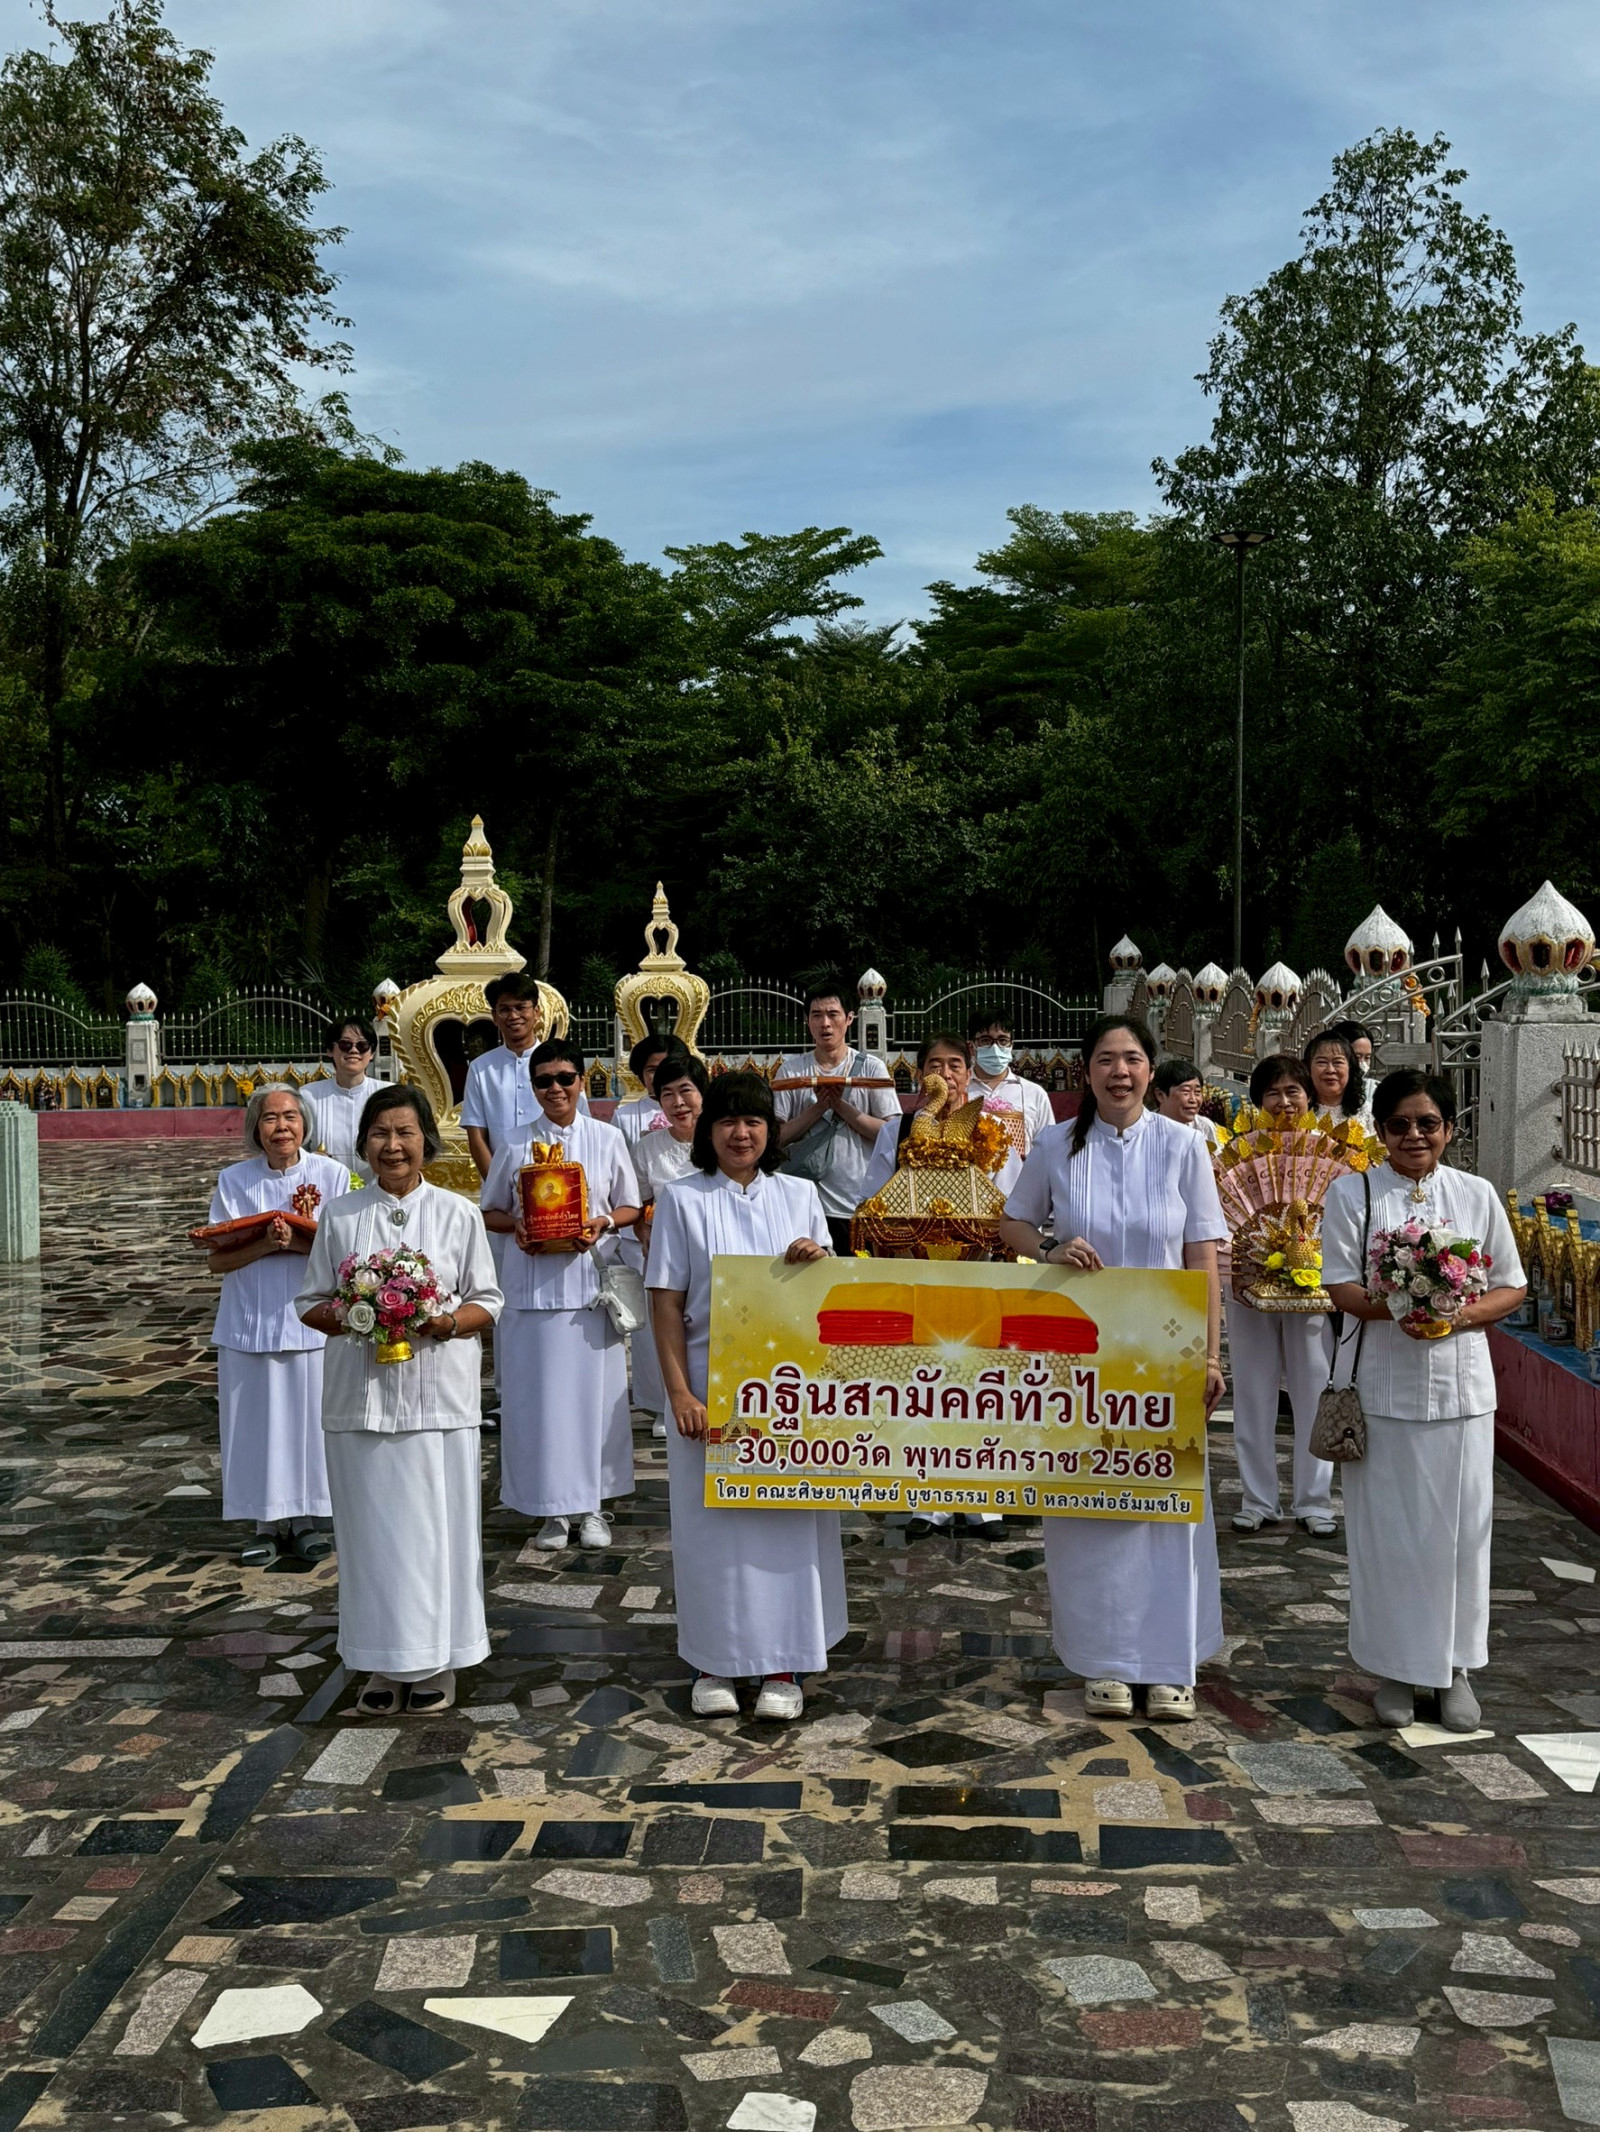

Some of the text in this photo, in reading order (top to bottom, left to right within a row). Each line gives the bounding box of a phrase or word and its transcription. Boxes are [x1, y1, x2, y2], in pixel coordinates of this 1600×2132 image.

[741, 1359, 1172, 1431] กฐินสามัคคีทั่วไทย
[903, 1436, 1080, 1480] พุทธศักราช
[1091, 1449, 1173, 1478] 2568
[716, 1479, 1191, 1513] โดย คณะศิษยานุศิษย์ บูชาธรรม 81 ปี หลวงพ่อธัมมชโย
